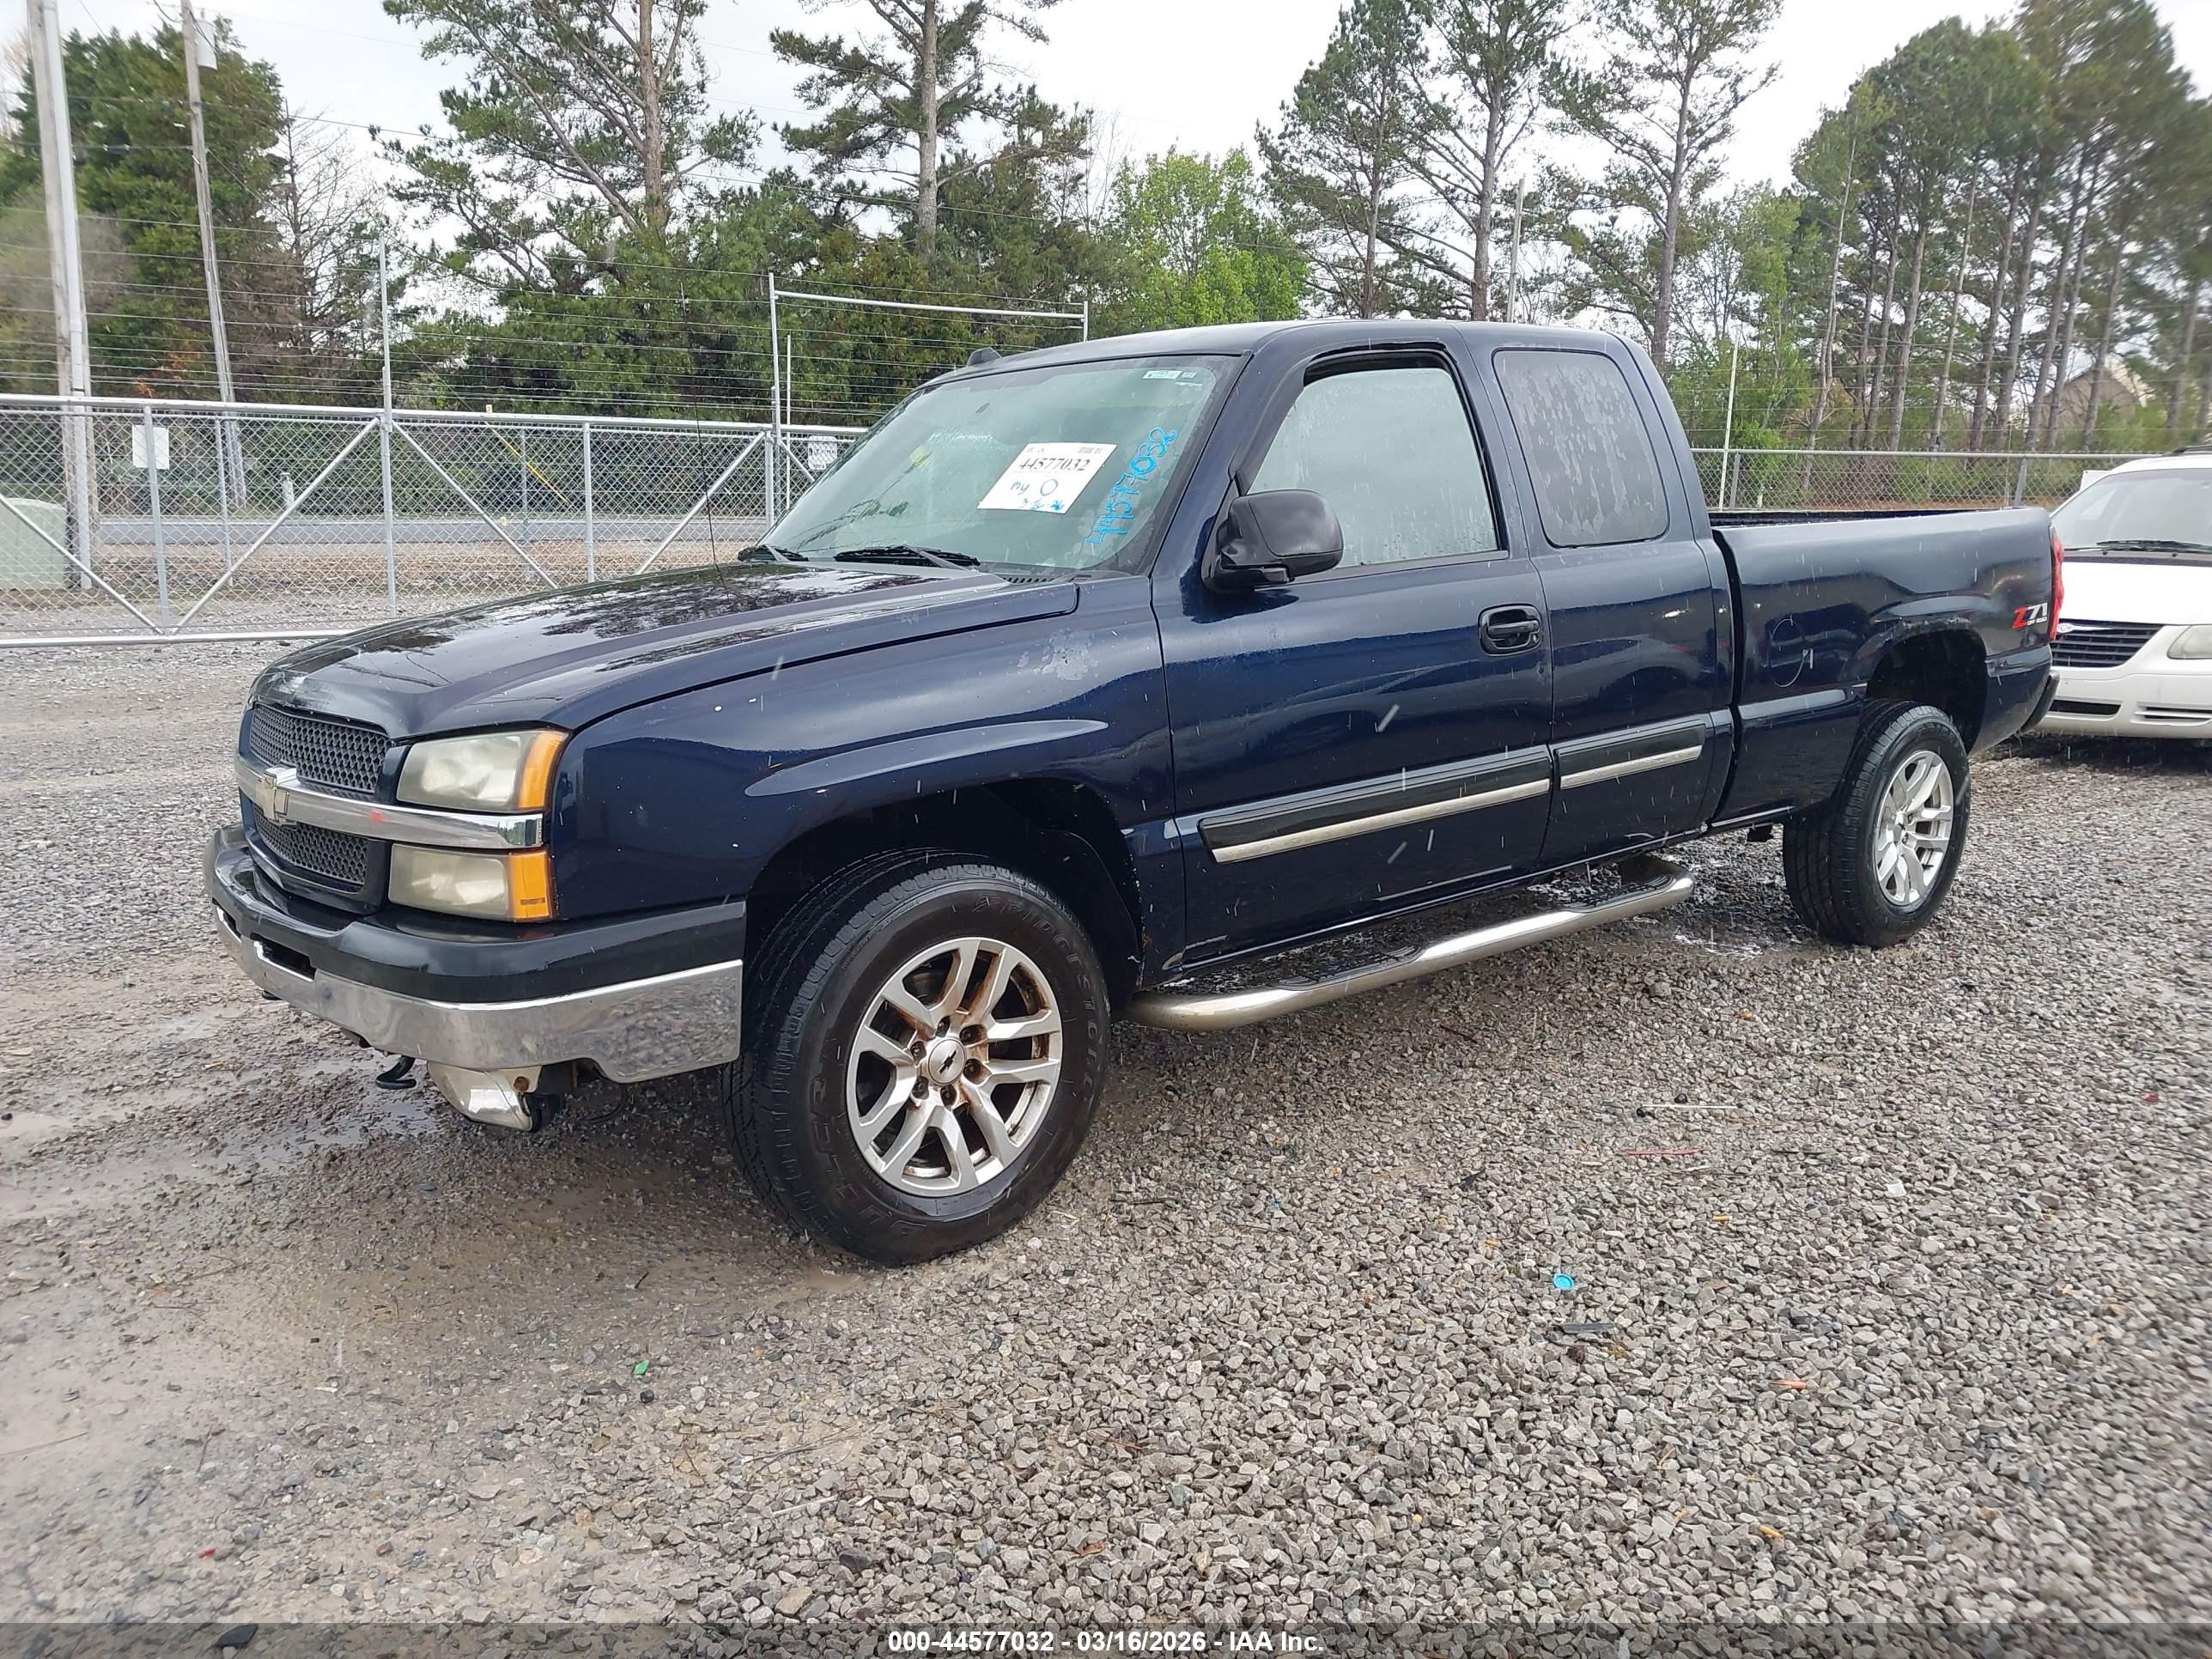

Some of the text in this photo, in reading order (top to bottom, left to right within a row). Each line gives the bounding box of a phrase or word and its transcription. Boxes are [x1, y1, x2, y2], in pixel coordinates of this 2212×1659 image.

[1018, 458, 1091, 471] 44577032
[1085, 427, 1177, 544] 44577032
[2013, 603, 2048, 629] Z71
